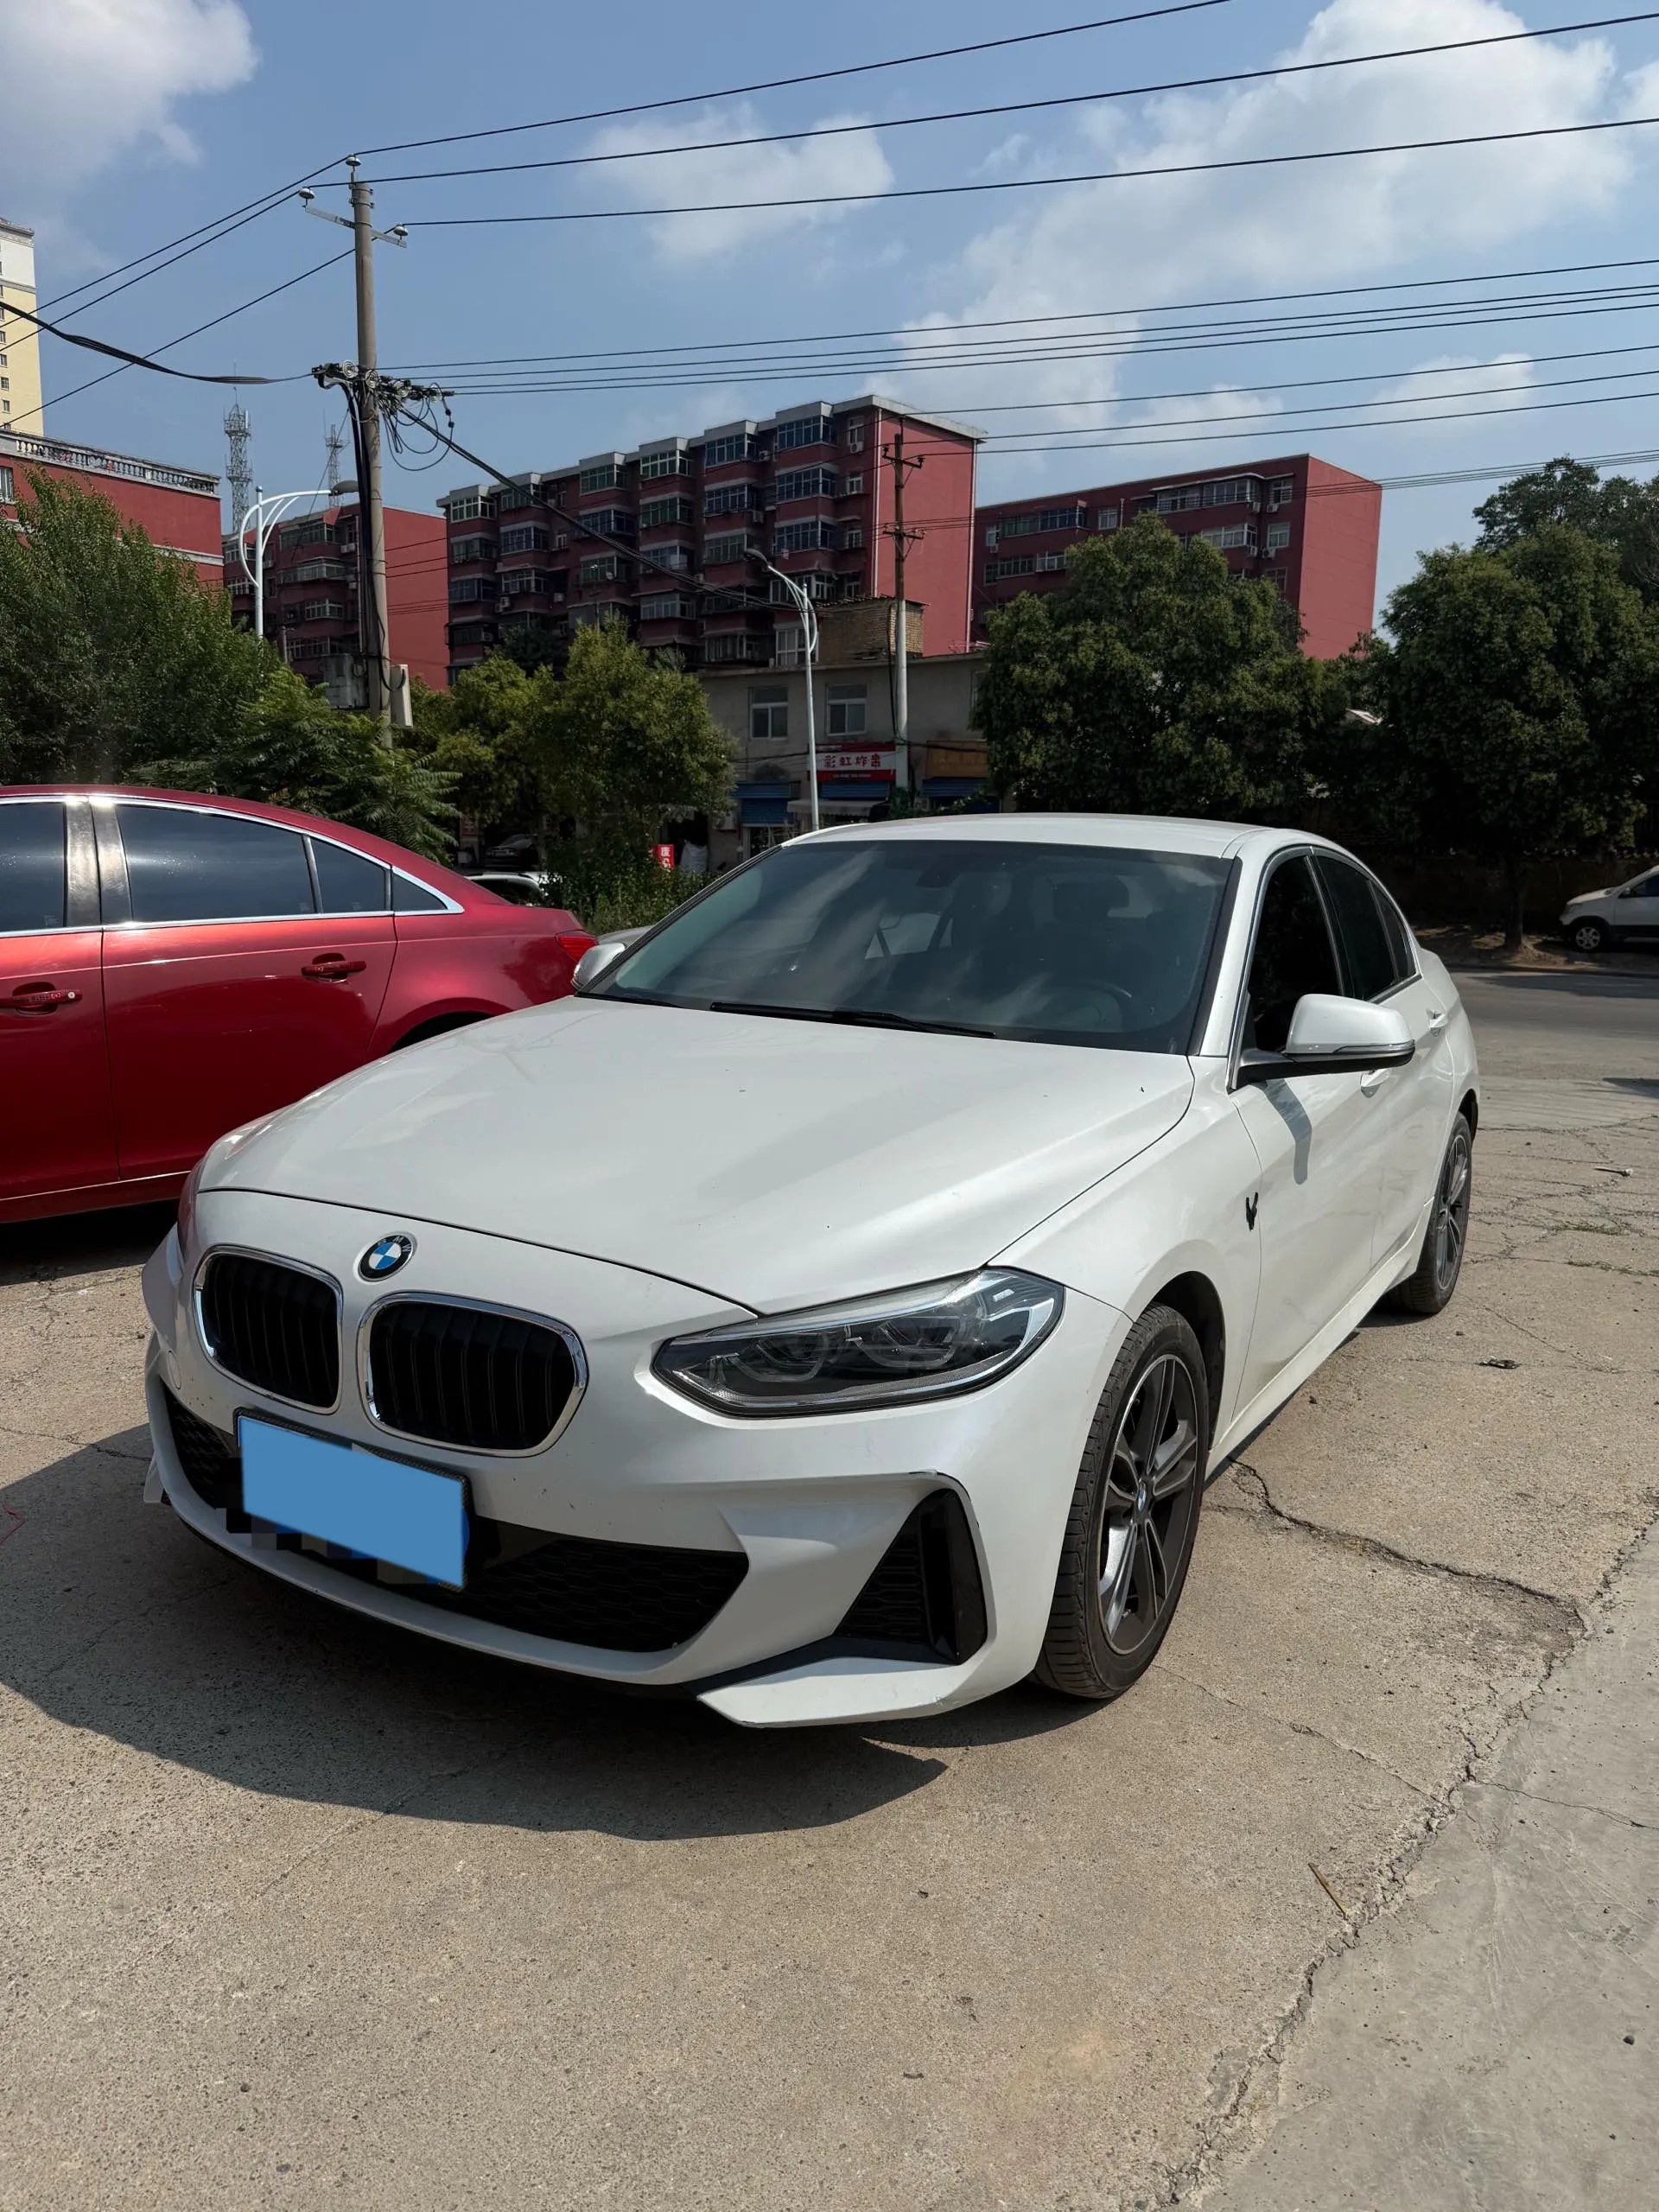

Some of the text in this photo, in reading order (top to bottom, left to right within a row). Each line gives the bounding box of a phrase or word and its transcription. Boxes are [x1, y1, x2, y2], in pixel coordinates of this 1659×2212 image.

[824, 753, 880, 768] 彩虹炸串
[378, 1236, 412, 1252] BMW
